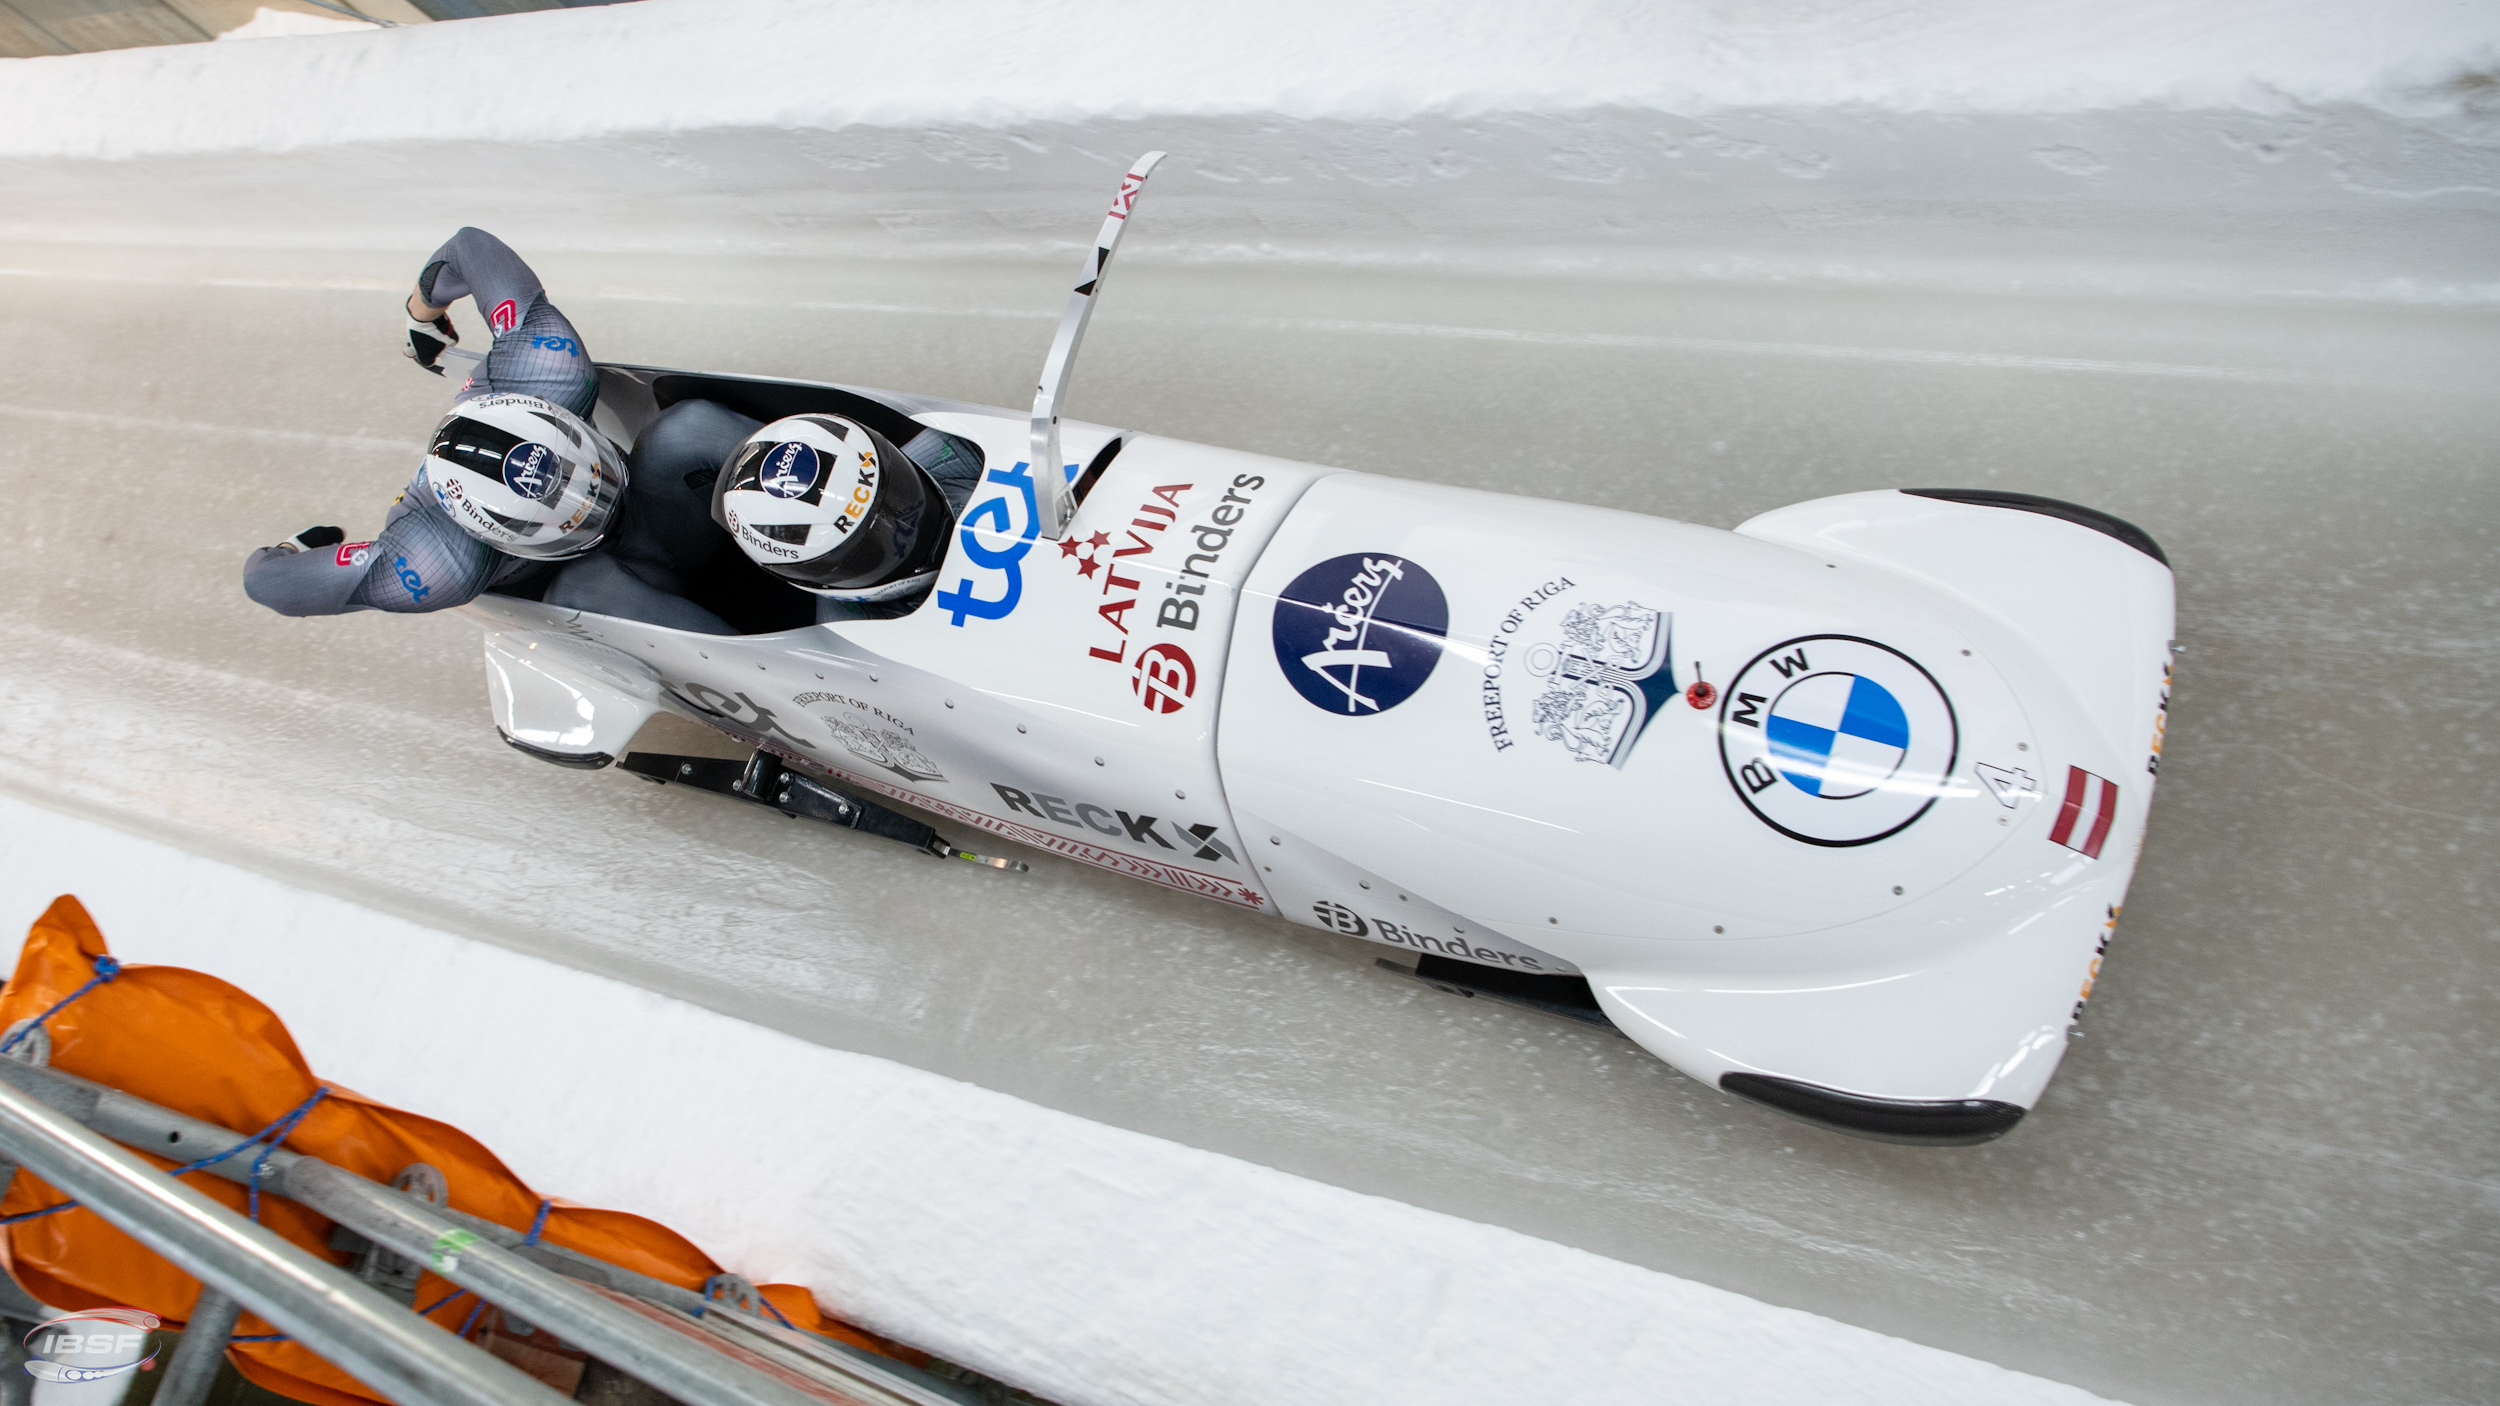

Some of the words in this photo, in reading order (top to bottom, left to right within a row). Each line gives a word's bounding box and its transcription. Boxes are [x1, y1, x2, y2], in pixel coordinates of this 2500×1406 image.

[479, 396, 545, 410] Binders
[741, 525, 799, 559] Binders
[1156, 473, 1265, 632] Binders
[394, 556, 430, 603] tet
[1089, 483, 1194, 664] LATVIJA
[1483, 635, 1514, 753] FREEPORT
[1500, 608, 1525, 635] OF
[1519, 576, 1577, 612] RIGA
[792, 691, 848, 708] FREEPORT
[848, 698, 870, 711] OF
[873, 706, 915, 737] RIGA
[1733, 648, 1810, 795] BMW
[1973, 761, 2037, 810] 4
[1371, 917, 1544, 972] Binders
